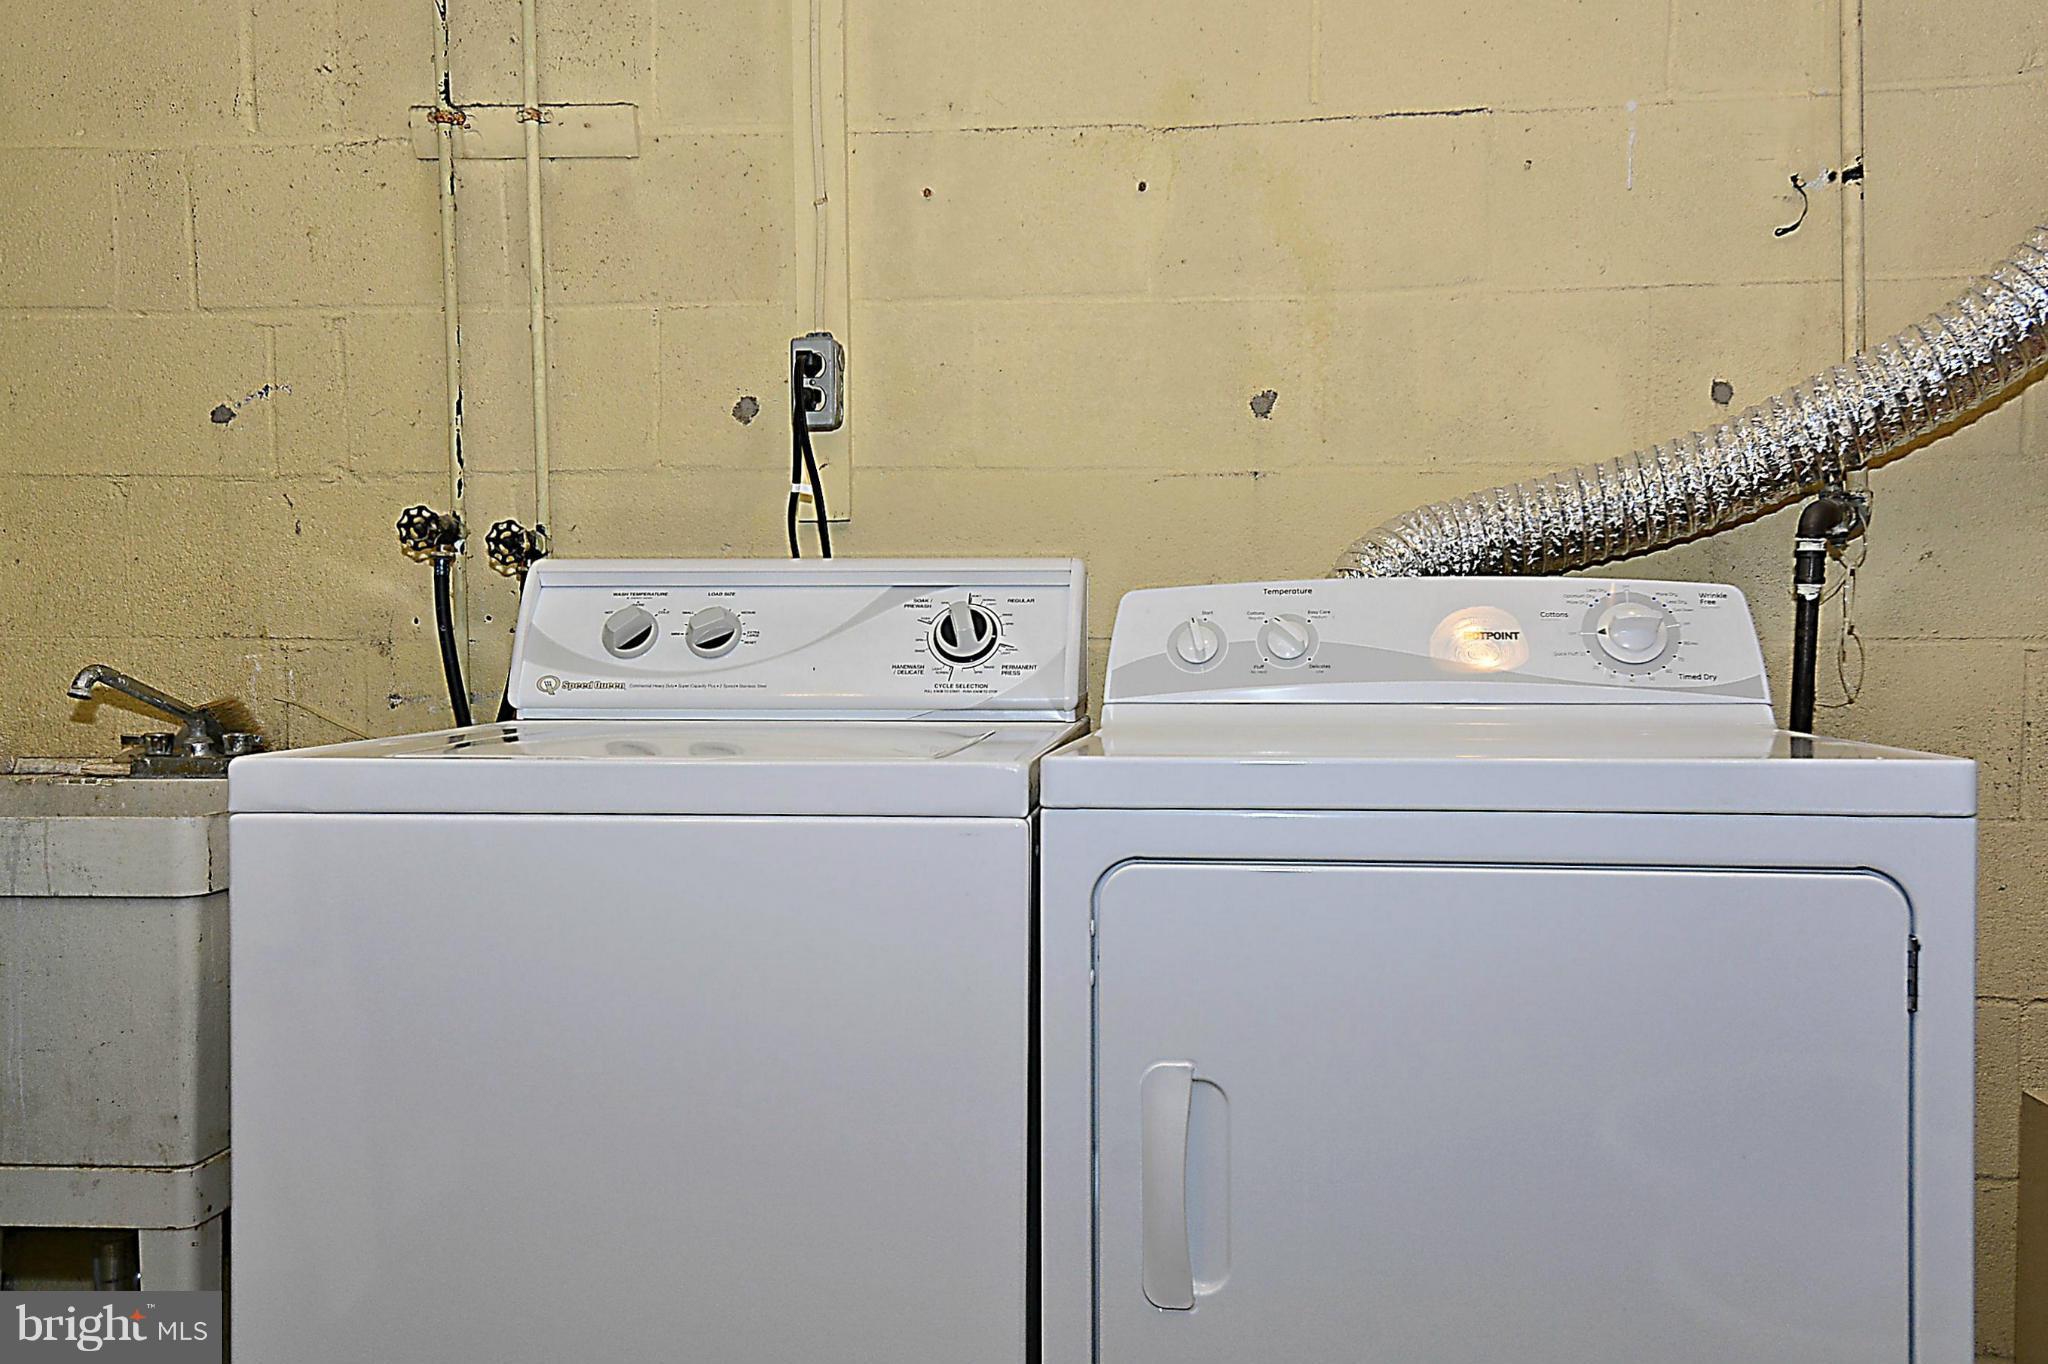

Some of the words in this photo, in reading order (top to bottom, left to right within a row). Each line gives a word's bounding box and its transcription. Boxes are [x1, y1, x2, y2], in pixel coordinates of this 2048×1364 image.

[1263, 588, 1313, 596] Temperature
[1464, 631, 1520, 640] OTPOINT
[1703, 673, 1717, 681] Dry
[561, 681, 593, 690] Speed
[594, 681, 626, 690] Queen
